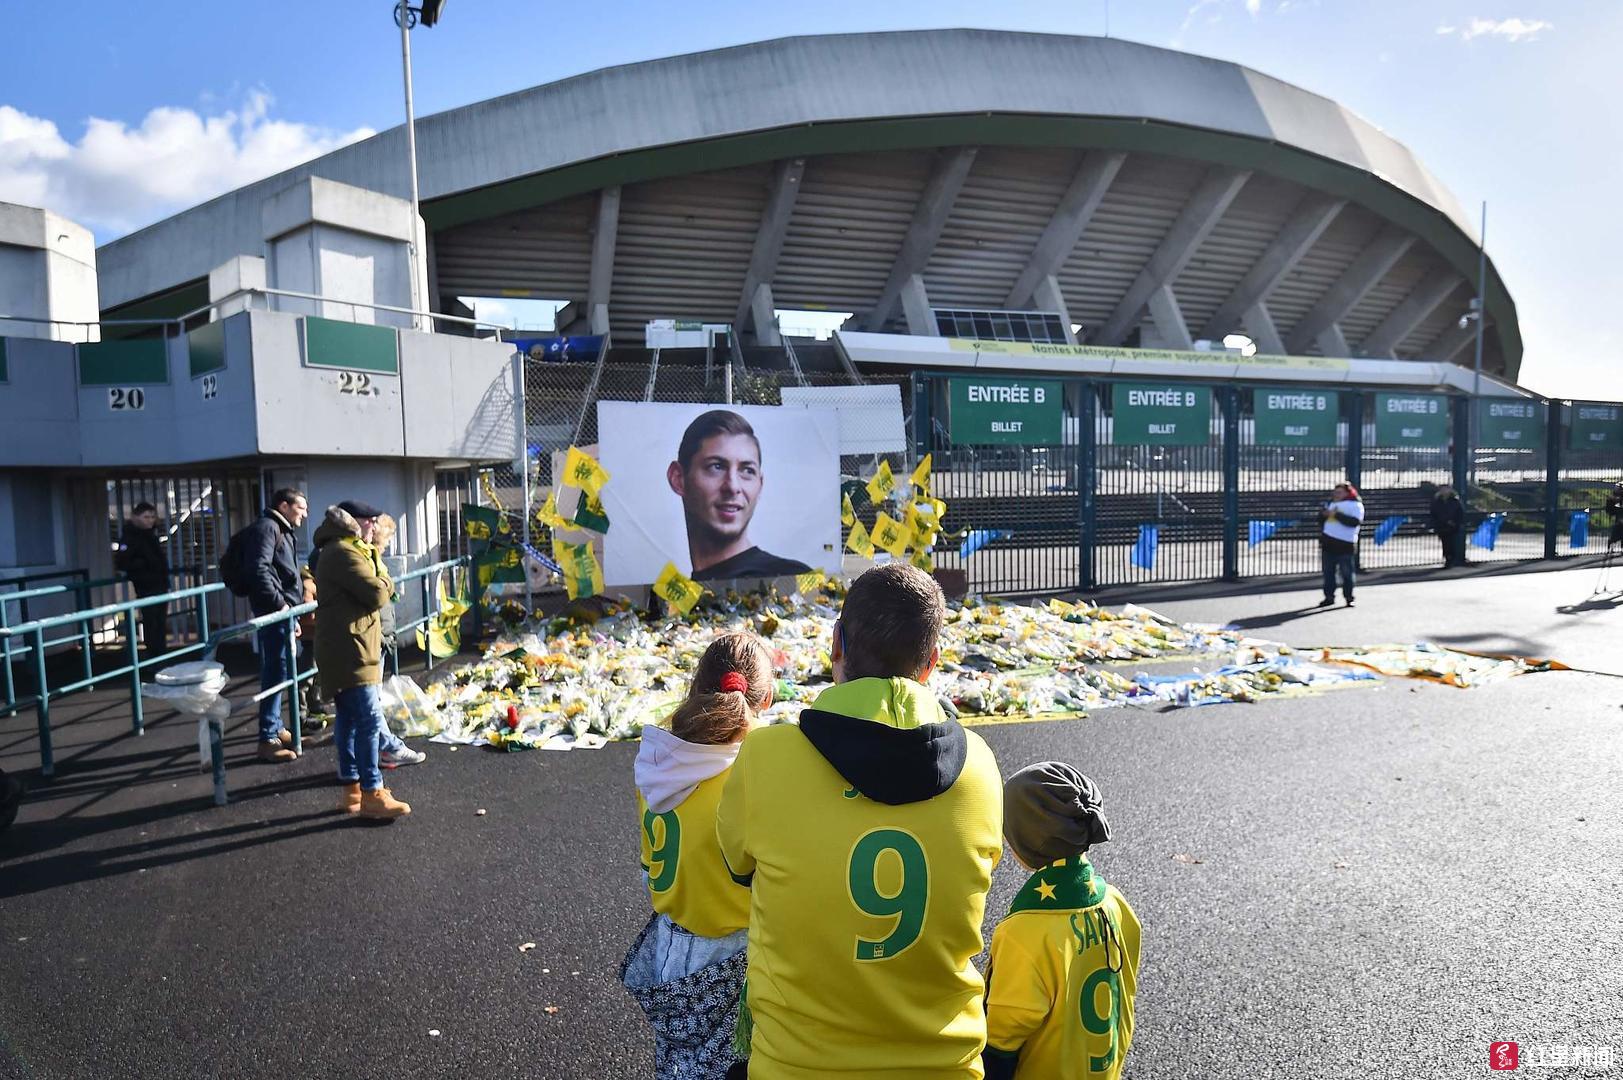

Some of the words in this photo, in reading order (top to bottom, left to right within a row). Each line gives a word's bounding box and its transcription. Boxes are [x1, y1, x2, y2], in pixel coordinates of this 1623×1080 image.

[1031, 344, 1071, 355] Nantes
[1133, 349, 1172, 360] premier
[203, 374, 217, 399] 22
[338, 372, 371, 396] 22
[109, 388, 145, 410] 20
[968, 384, 1030, 404] ENTRÉE
[1033, 388, 1046, 404] B
[1128, 388, 1182, 407] ENTRÉE
[1185, 391, 1196, 407] B
[1268, 393, 1315, 410] ENTRÉE
[1316, 396, 1326, 411] B
[1387, 398, 1428, 413] ENTRÉE
[991, 421, 1023, 433] BILLET
[1148, 424, 1176, 434] BILLET
[1284, 426, 1309, 436] BILLET
[642, 807, 682, 894] 9
[846, 826, 931, 962] 9
[1079, 967, 1121, 1073] 9
